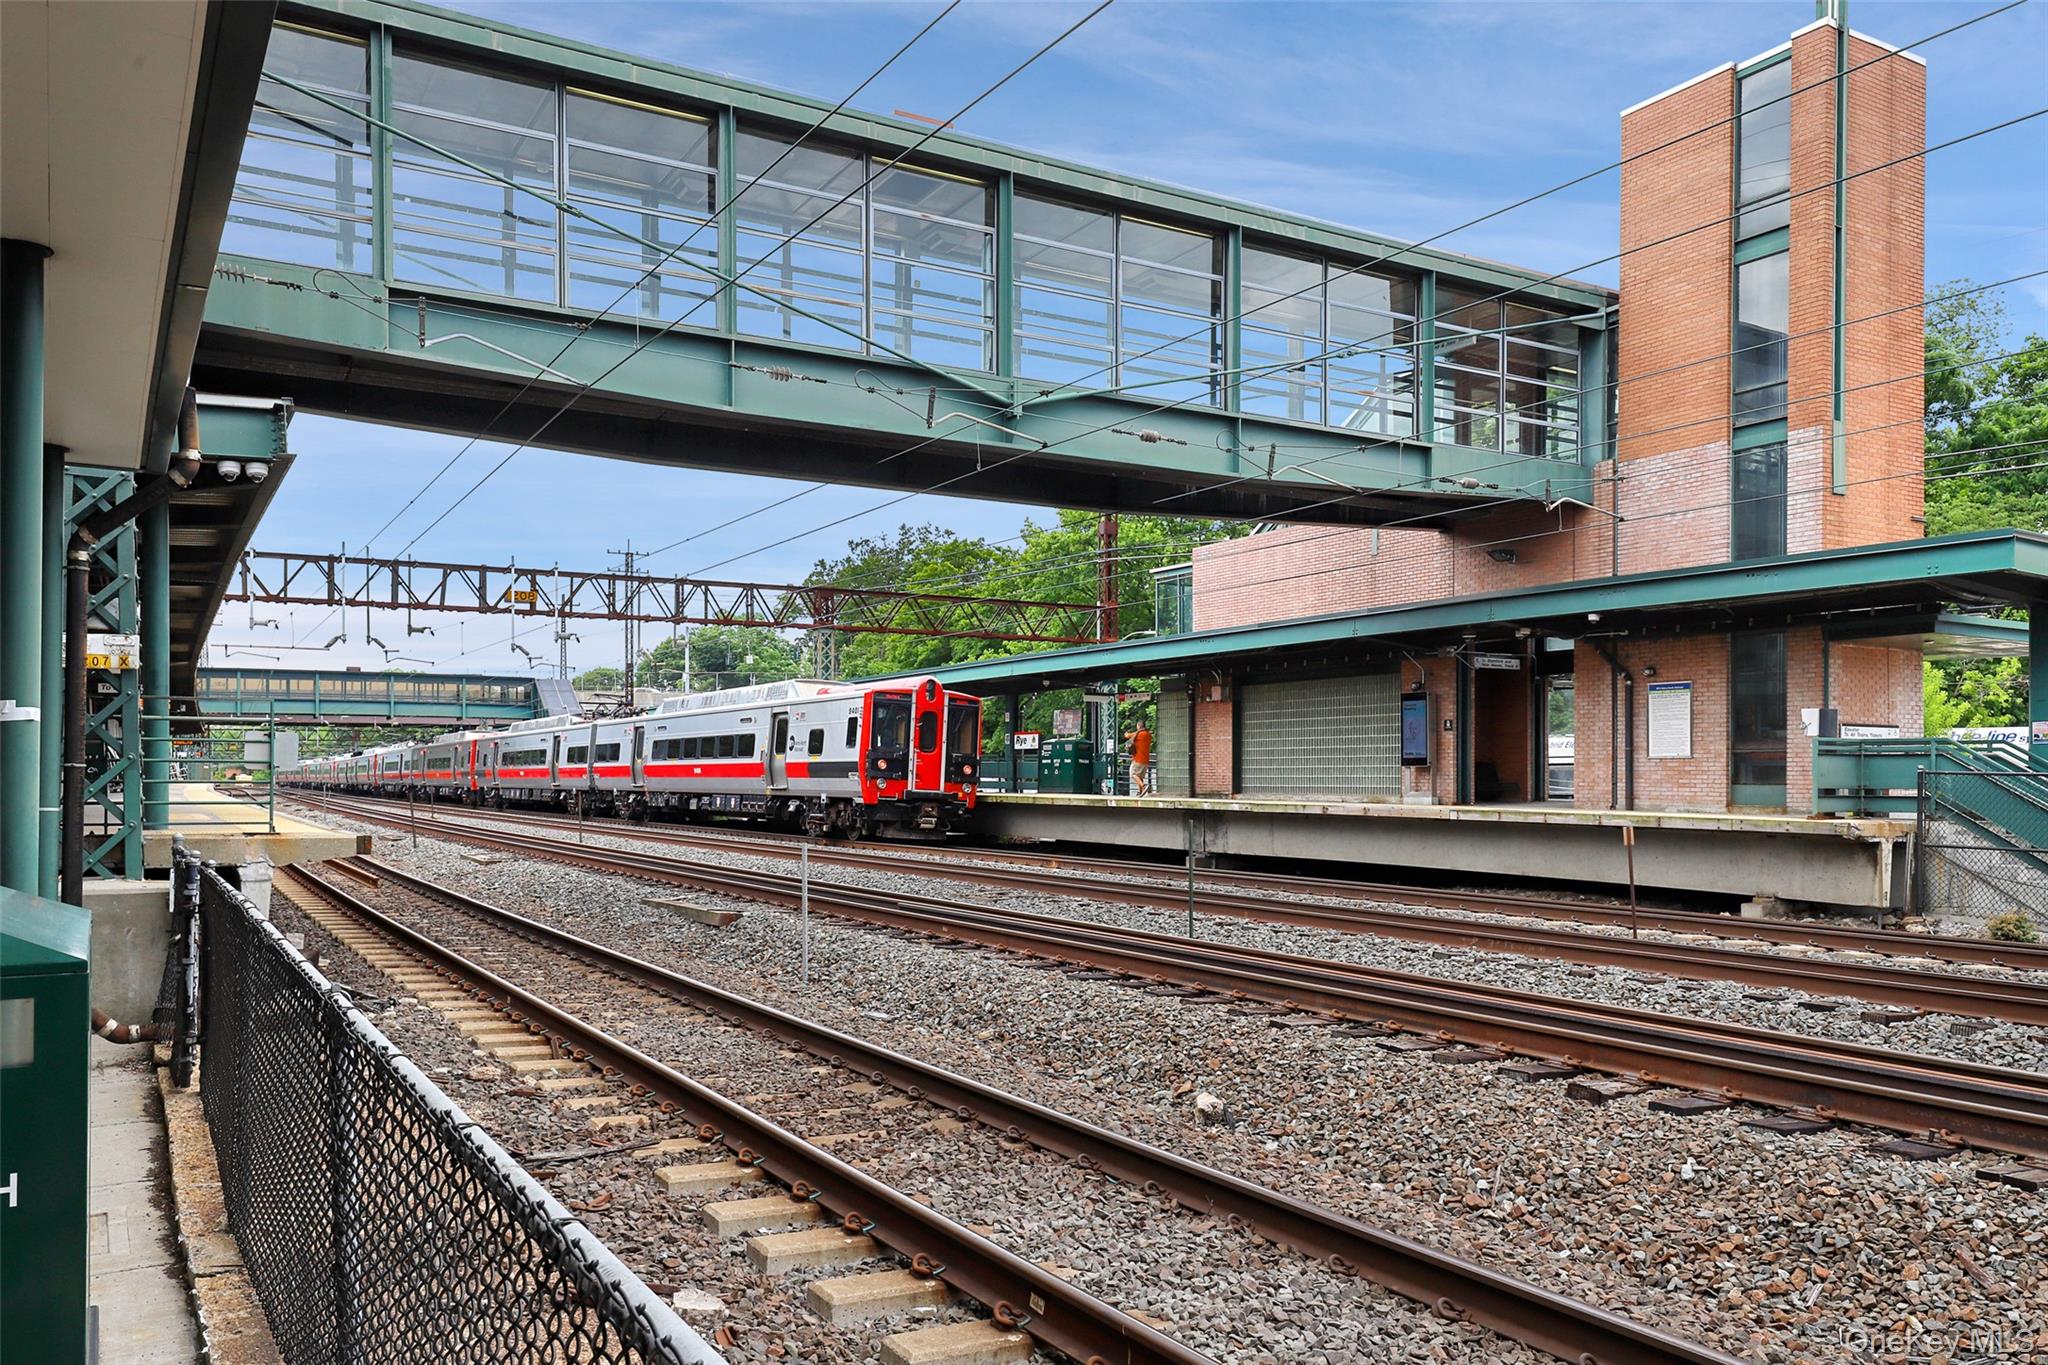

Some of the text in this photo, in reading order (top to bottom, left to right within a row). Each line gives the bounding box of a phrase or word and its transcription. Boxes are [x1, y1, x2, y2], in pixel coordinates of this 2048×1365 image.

[84, 656, 129, 667] 07 X
[1015, 734, 1028, 745] Rye
